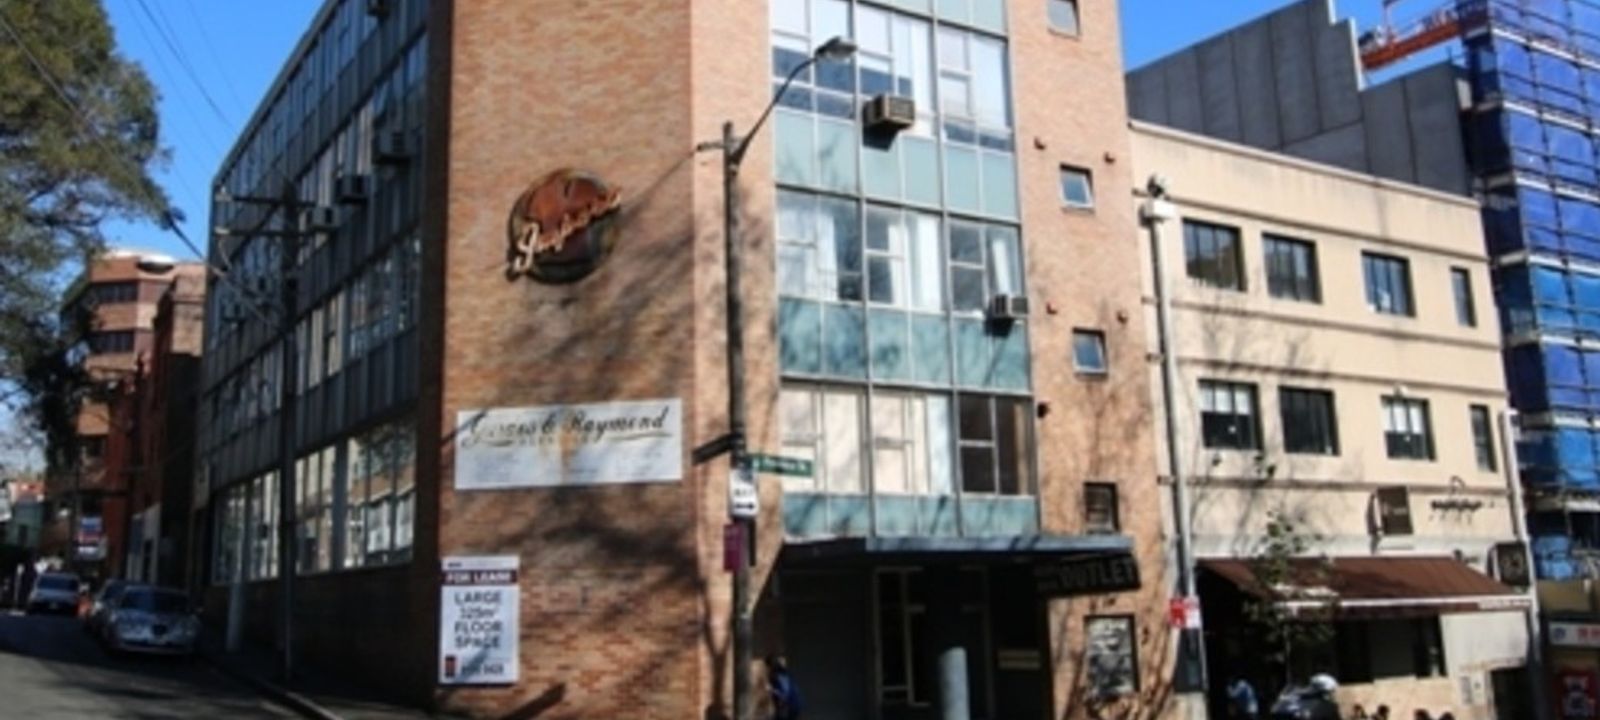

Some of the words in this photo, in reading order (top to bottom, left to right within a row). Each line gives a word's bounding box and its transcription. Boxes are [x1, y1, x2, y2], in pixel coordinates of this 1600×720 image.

[445, 572, 470, 583] FOR
[1060, 559, 1135, 588] OUTLET
[454, 592, 502, 604] LARGE
[454, 621, 502, 634] FLOOR
[455, 636, 500, 648] SPACE
